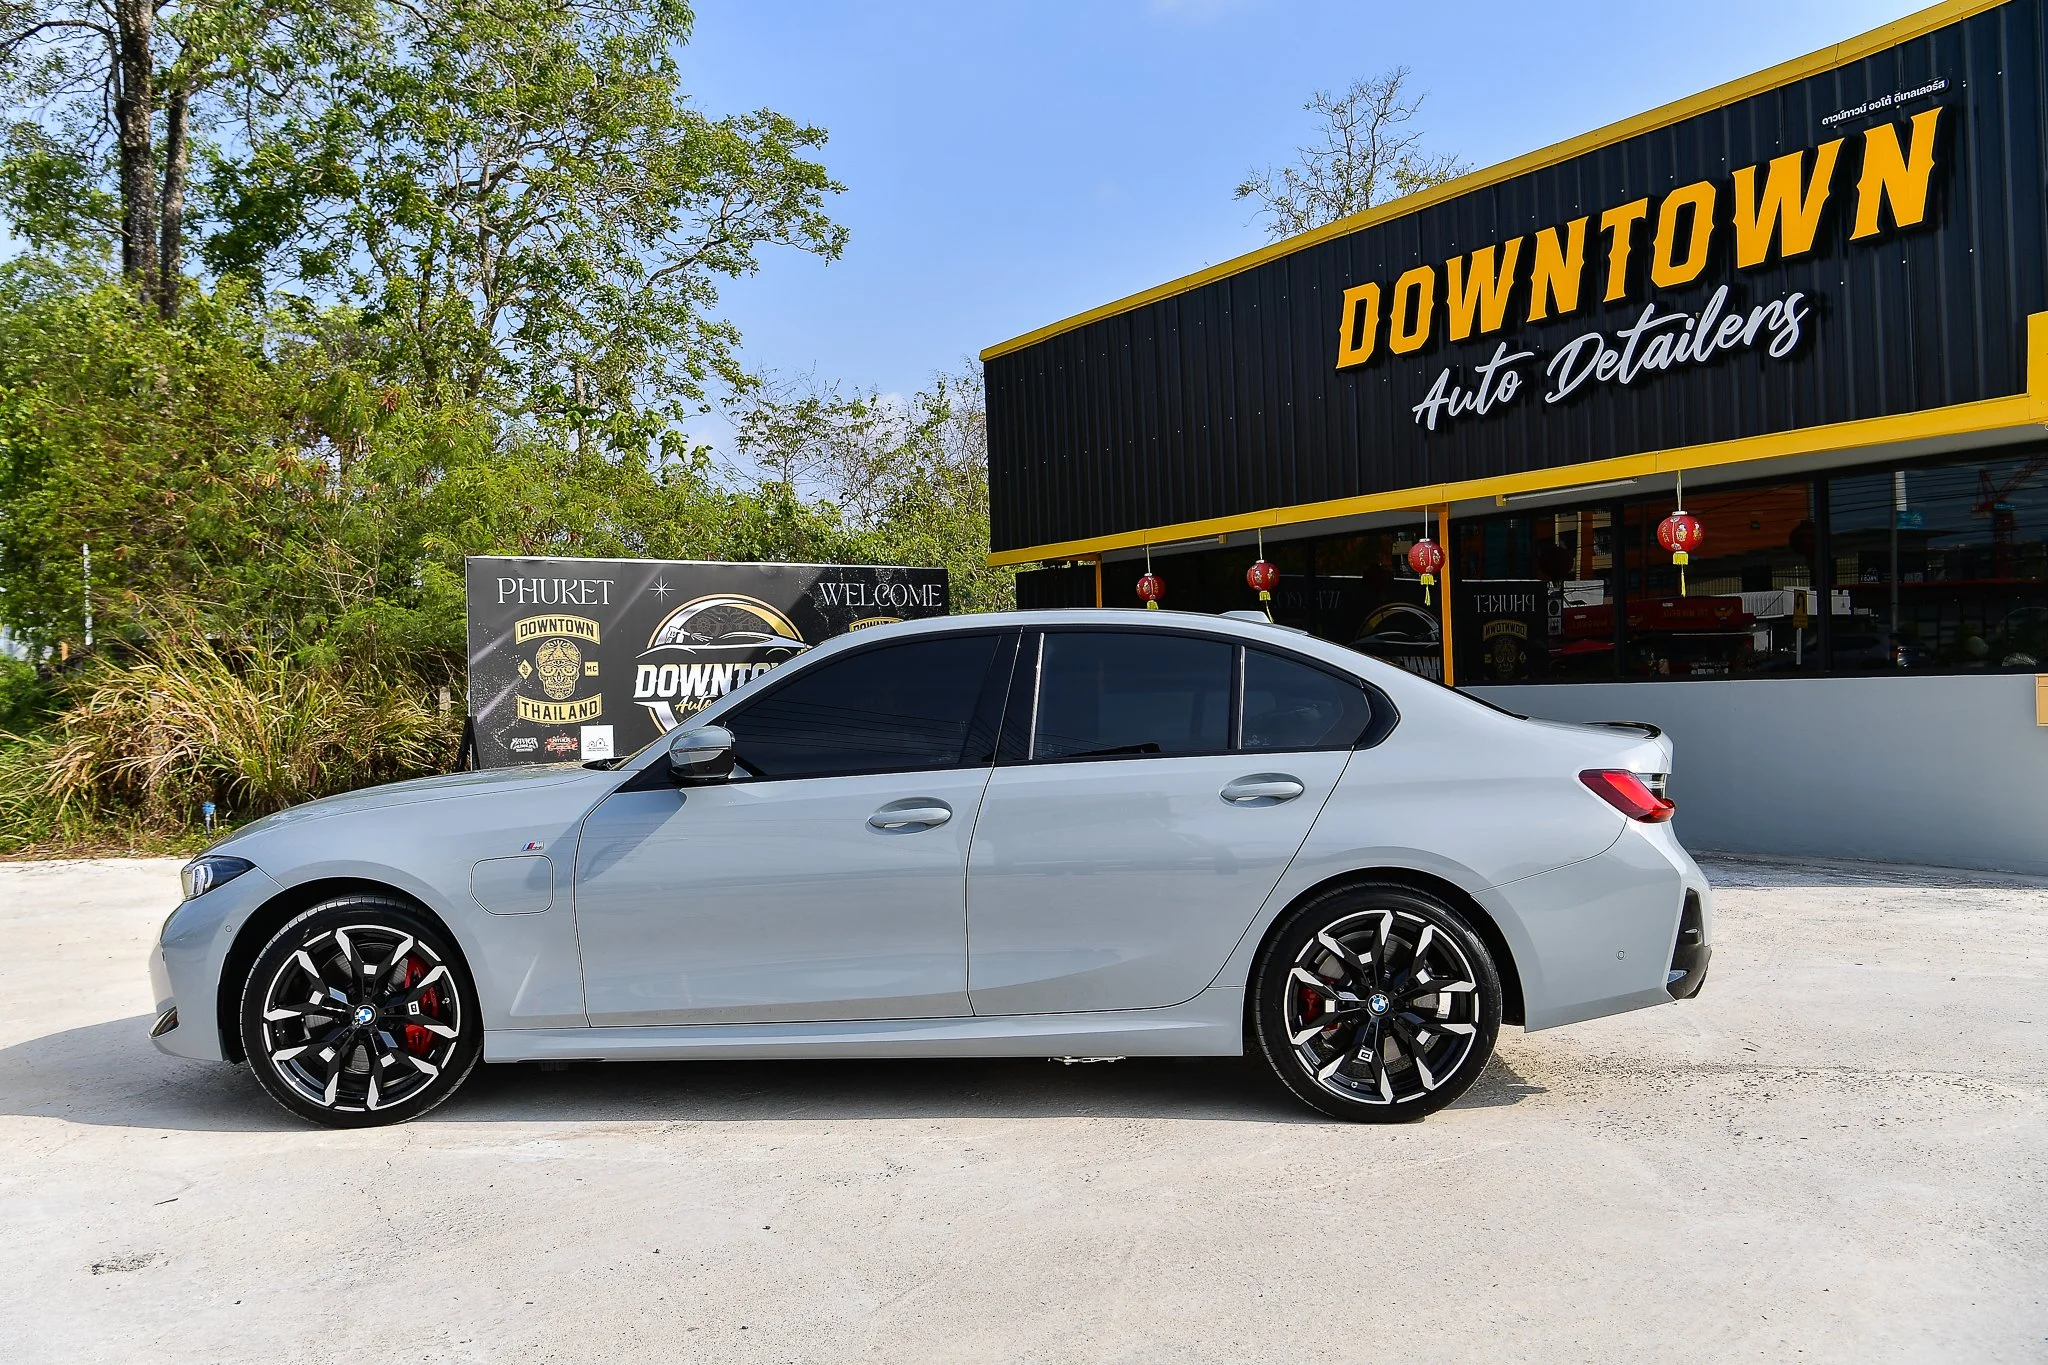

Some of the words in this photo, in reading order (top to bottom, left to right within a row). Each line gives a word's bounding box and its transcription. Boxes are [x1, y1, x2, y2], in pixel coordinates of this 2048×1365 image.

[1822, 103, 1866, 125] ดาวน์ทาวน์
[1868, 94, 1892, 111] ออโต้
[1336, 107, 1943, 369] DOWNTOWN
[1412, 342, 1535, 432] Auto
[1544, 285, 1810, 405] Detailers
[497, 577, 615, 605] PHUKET
[817, 583, 942, 607] WELCOME
[520, 618, 595, 637] DOWNTOWN
[633, 663, 780, 698] DOWNT
[521, 701, 598, 721] THAILAND
